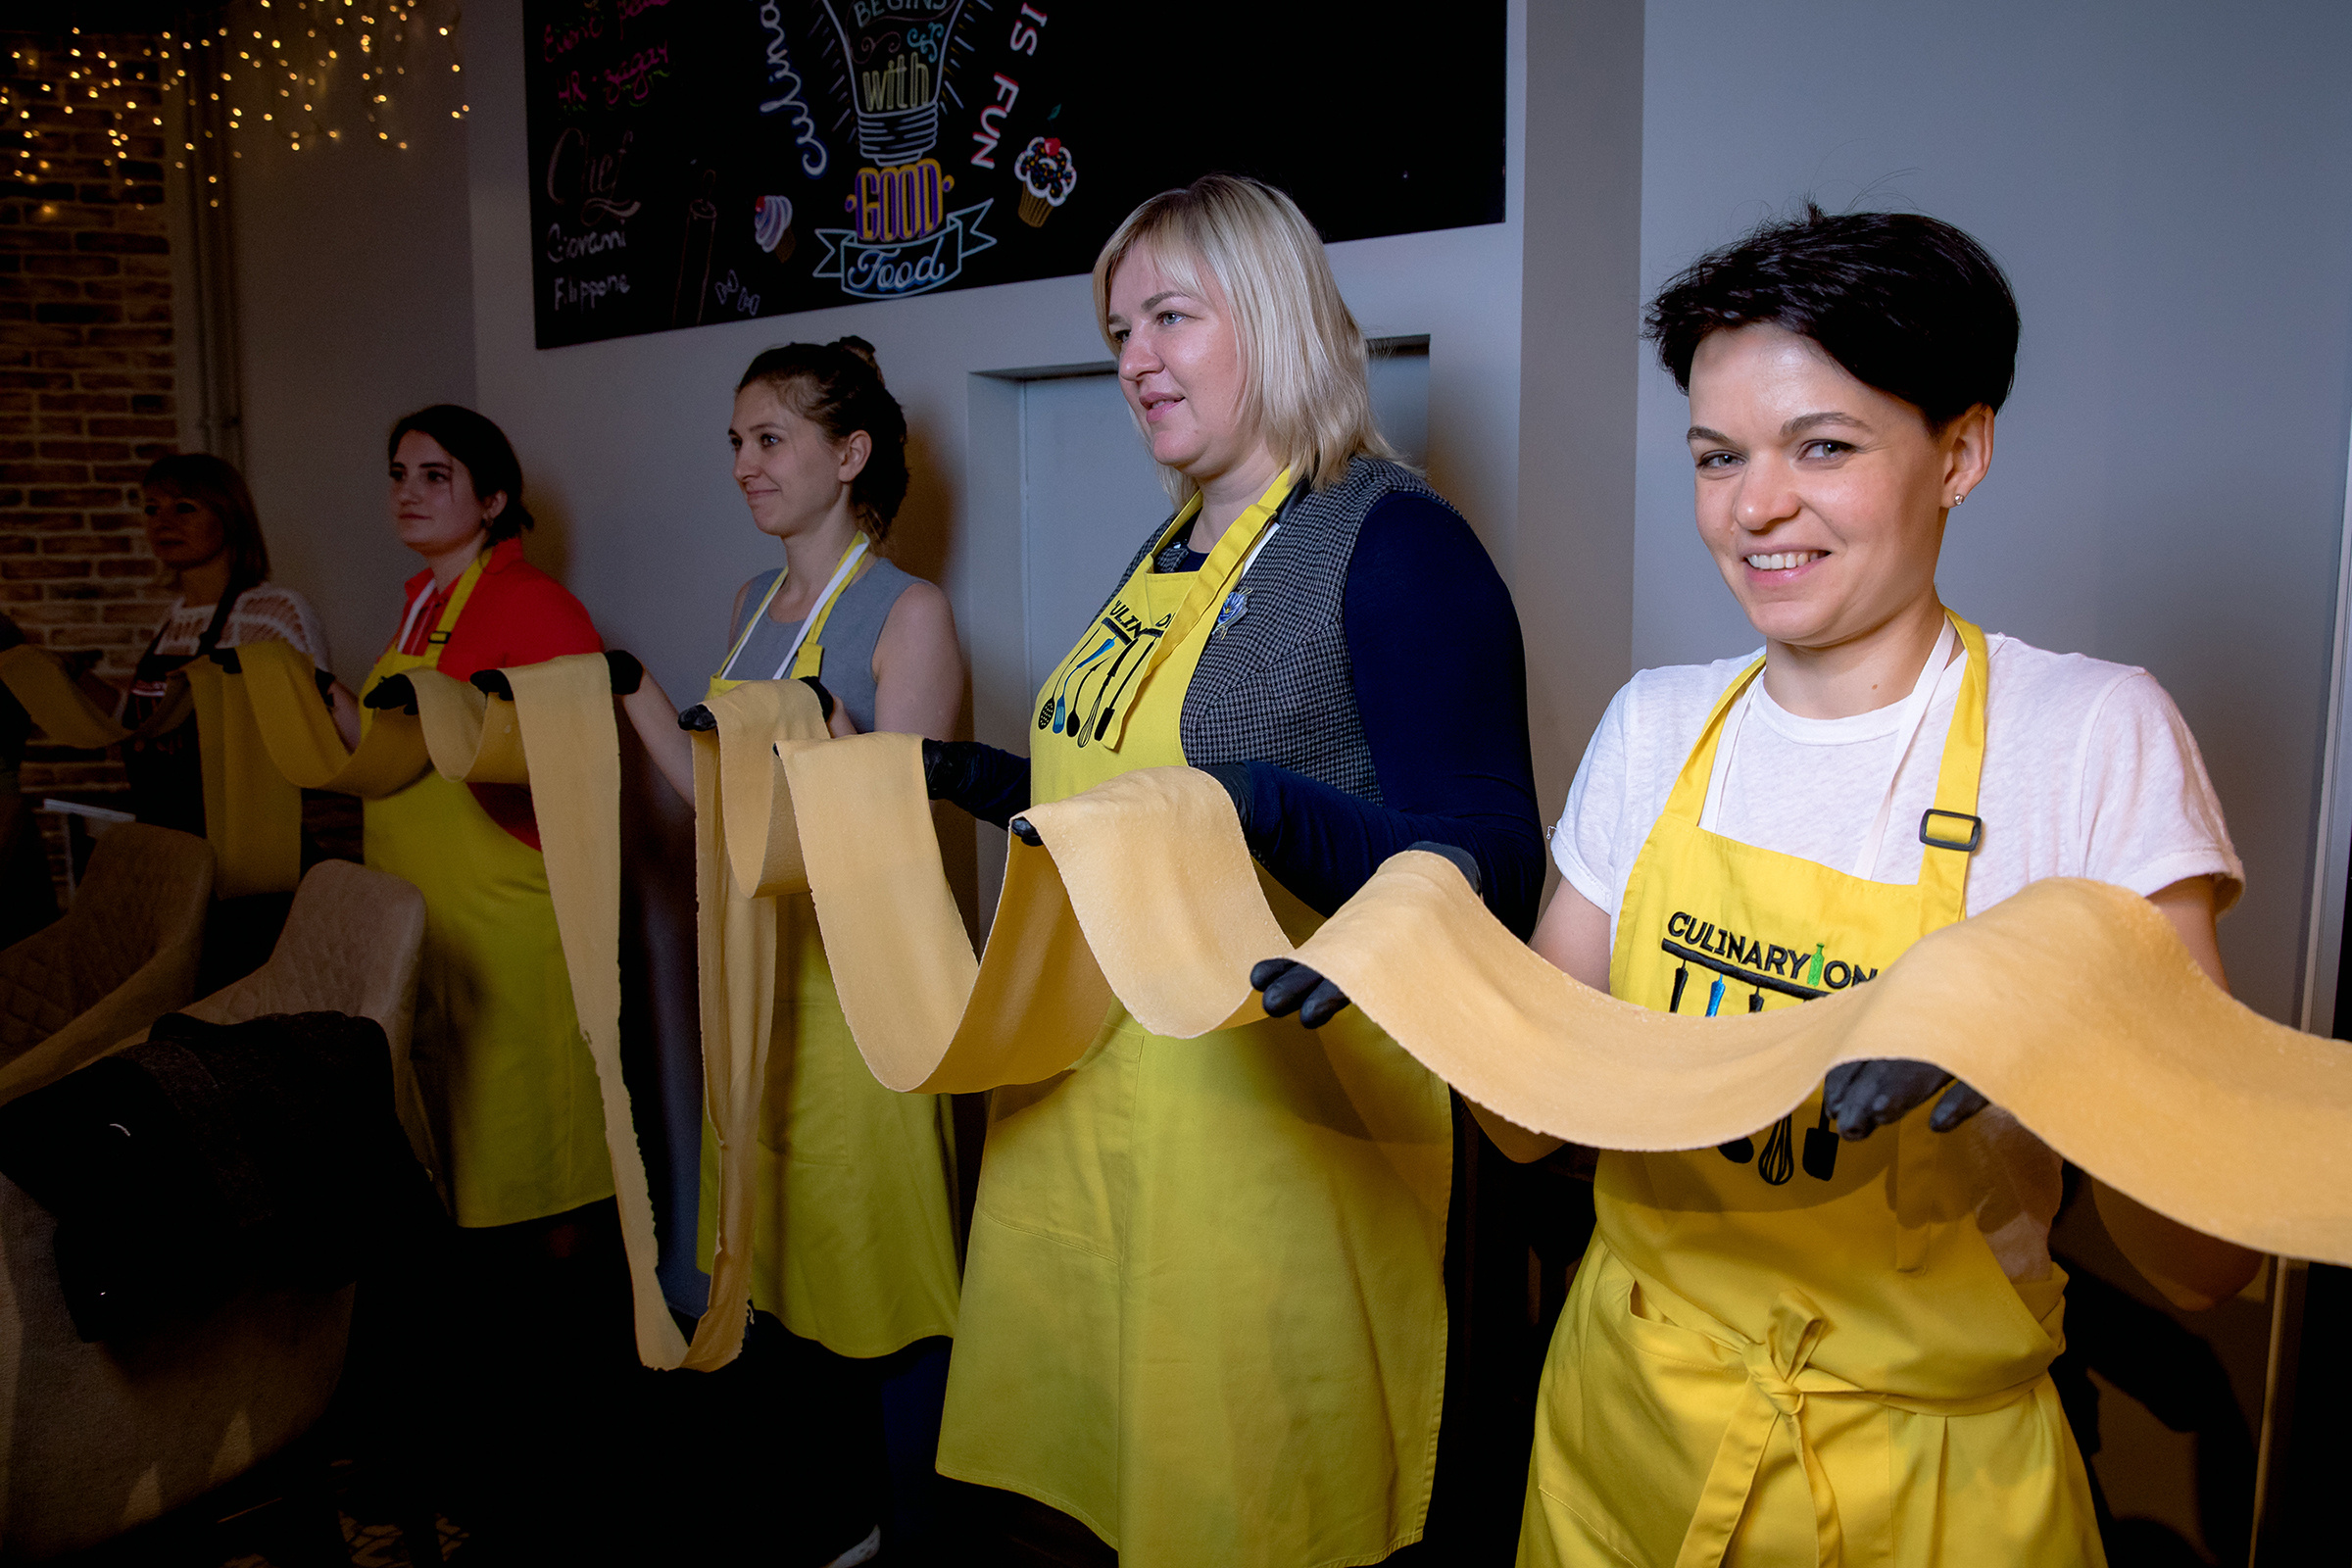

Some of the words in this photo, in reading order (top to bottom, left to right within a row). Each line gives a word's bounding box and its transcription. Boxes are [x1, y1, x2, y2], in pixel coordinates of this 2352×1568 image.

[1009, 2, 1048, 57] IS
[861, 51, 930, 112] with
[971, 72, 1020, 170] FUN
[547, 126, 642, 226] Chef
[855, 158, 944, 242] GOOD
[848, 236, 945, 291] Food
